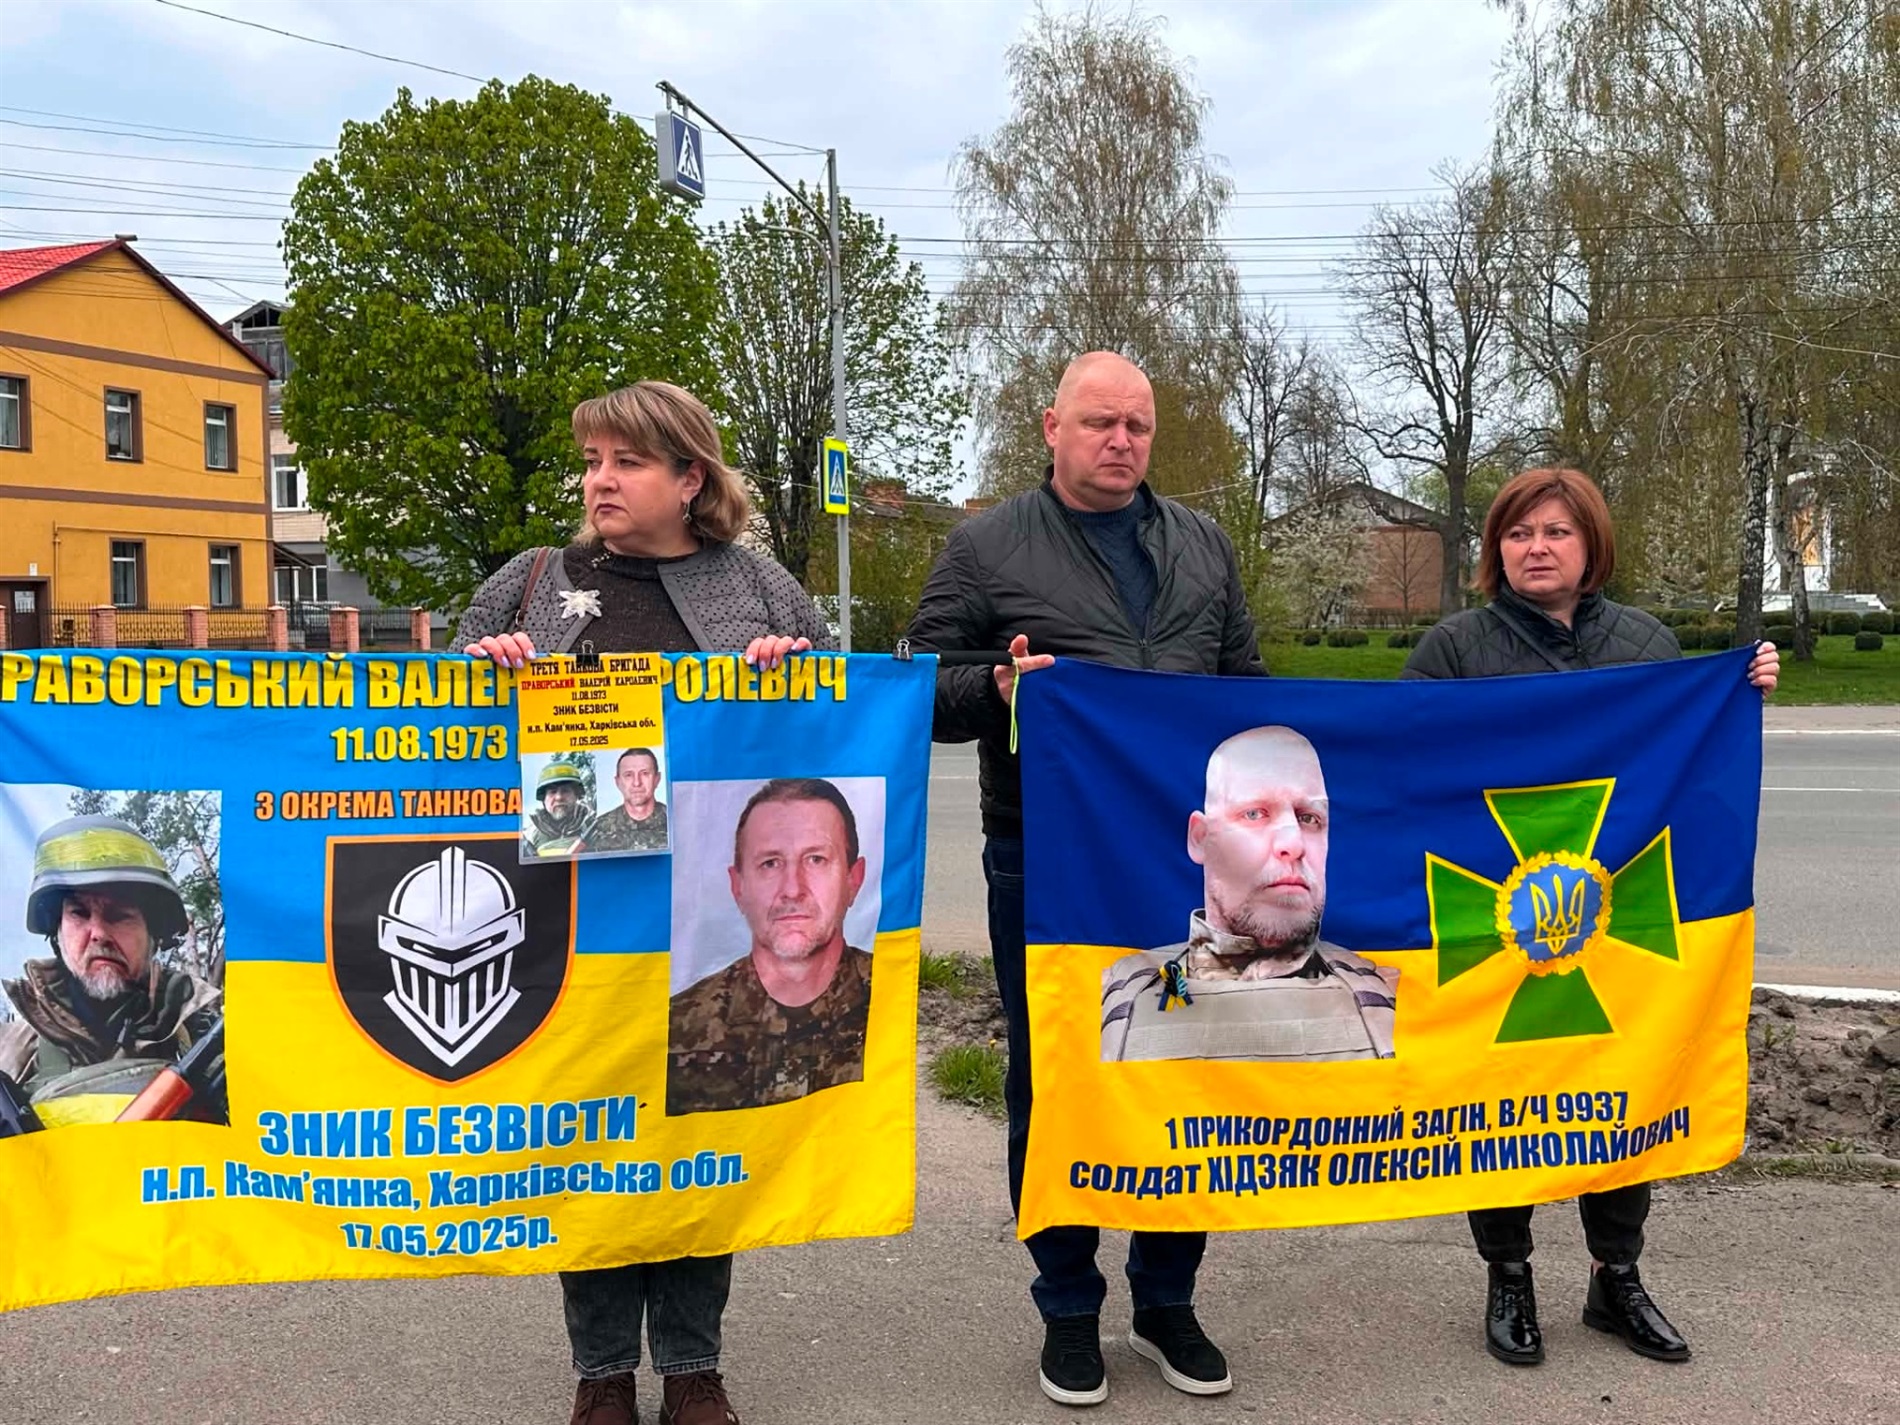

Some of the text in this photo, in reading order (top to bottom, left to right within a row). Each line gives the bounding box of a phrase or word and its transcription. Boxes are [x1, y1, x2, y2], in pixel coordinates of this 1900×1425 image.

[0, 652, 355, 708] РАВОРСЬКИЙ
[521, 677, 575, 690] ПРАВОРСЬКИЙ
[579, 675, 611, 688] ВАЛЕРІЙ
[530, 662, 559, 676] ТРЕТЯ
[609, 657, 651, 672] БРИГАДА
[553, 703, 618, 716] ЗНИК БЕЗВІСТИ
[571, 690, 607, 701] 11.08.1973
[570, 735, 608, 746] 17.05.2025
[589, 719, 638, 732] Харківська
[639, 717, 657, 728] обл.
[331, 724, 509, 763] 11.08.1973
[281, 790, 395, 820] ОКРЕМА
[400, 787, 522, 818] ТАНКОВА
[259, 1094, 638, 1159] ЗНИК БЕЗВІСТИ
[1164, 1091, 1628, 1150] 1 ПРИКОРДОННИЙ ЗАГІН, В/Ч 9937
[1069, 1106, 1690, 1200] солдат ХІДЗЯК ОЛЕКСІЙ МИКОЛАЙОВИЧ
[429, 1160, 662, 1210] Харківська
[670, 1150, 750, 1191] обл.
[339, 1213, 559, 1259] 17.05.2025р.
